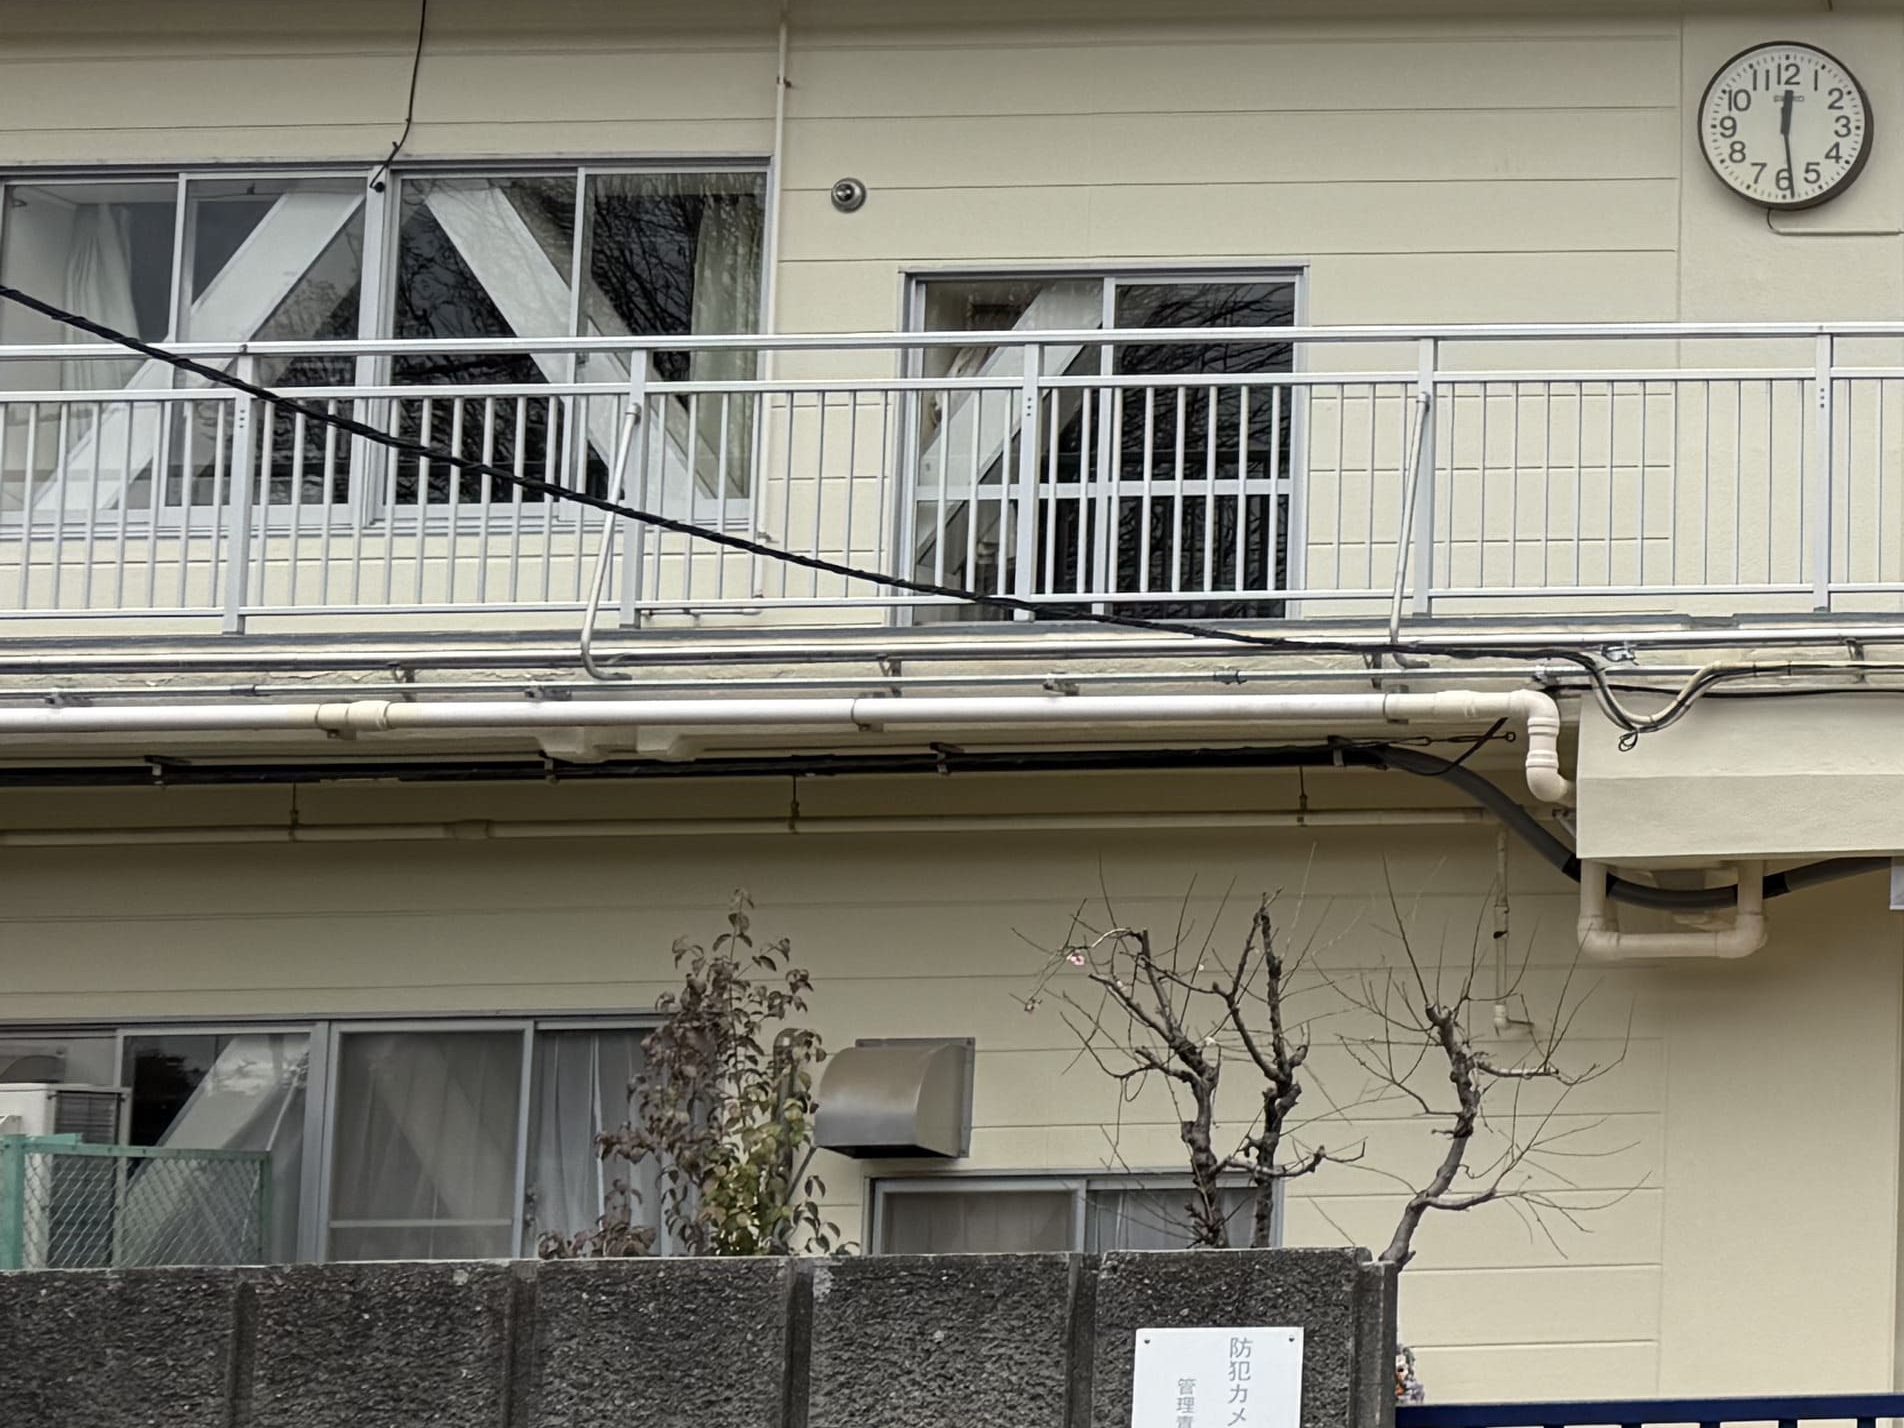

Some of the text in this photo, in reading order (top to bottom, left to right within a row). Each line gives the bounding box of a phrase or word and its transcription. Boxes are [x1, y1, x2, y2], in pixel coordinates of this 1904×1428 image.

[1753, 69, 1770, 91] 11
[1777, 63, 1801, 86] 12
[1728, 88, 1752, 112] 10
[1827, 88, 1844, 110] 2
[1719, 116, 1737, 139] 9
[1834, 115, 1851, 138] 3
[1728, 140, 1746, 163] 8
[1824, 141, 1843, 164] 4
[1750, 162, 1767, 185] 7
[1775, 168, 1792, 191] 6
[1803, 161, 1821, 184] 5
